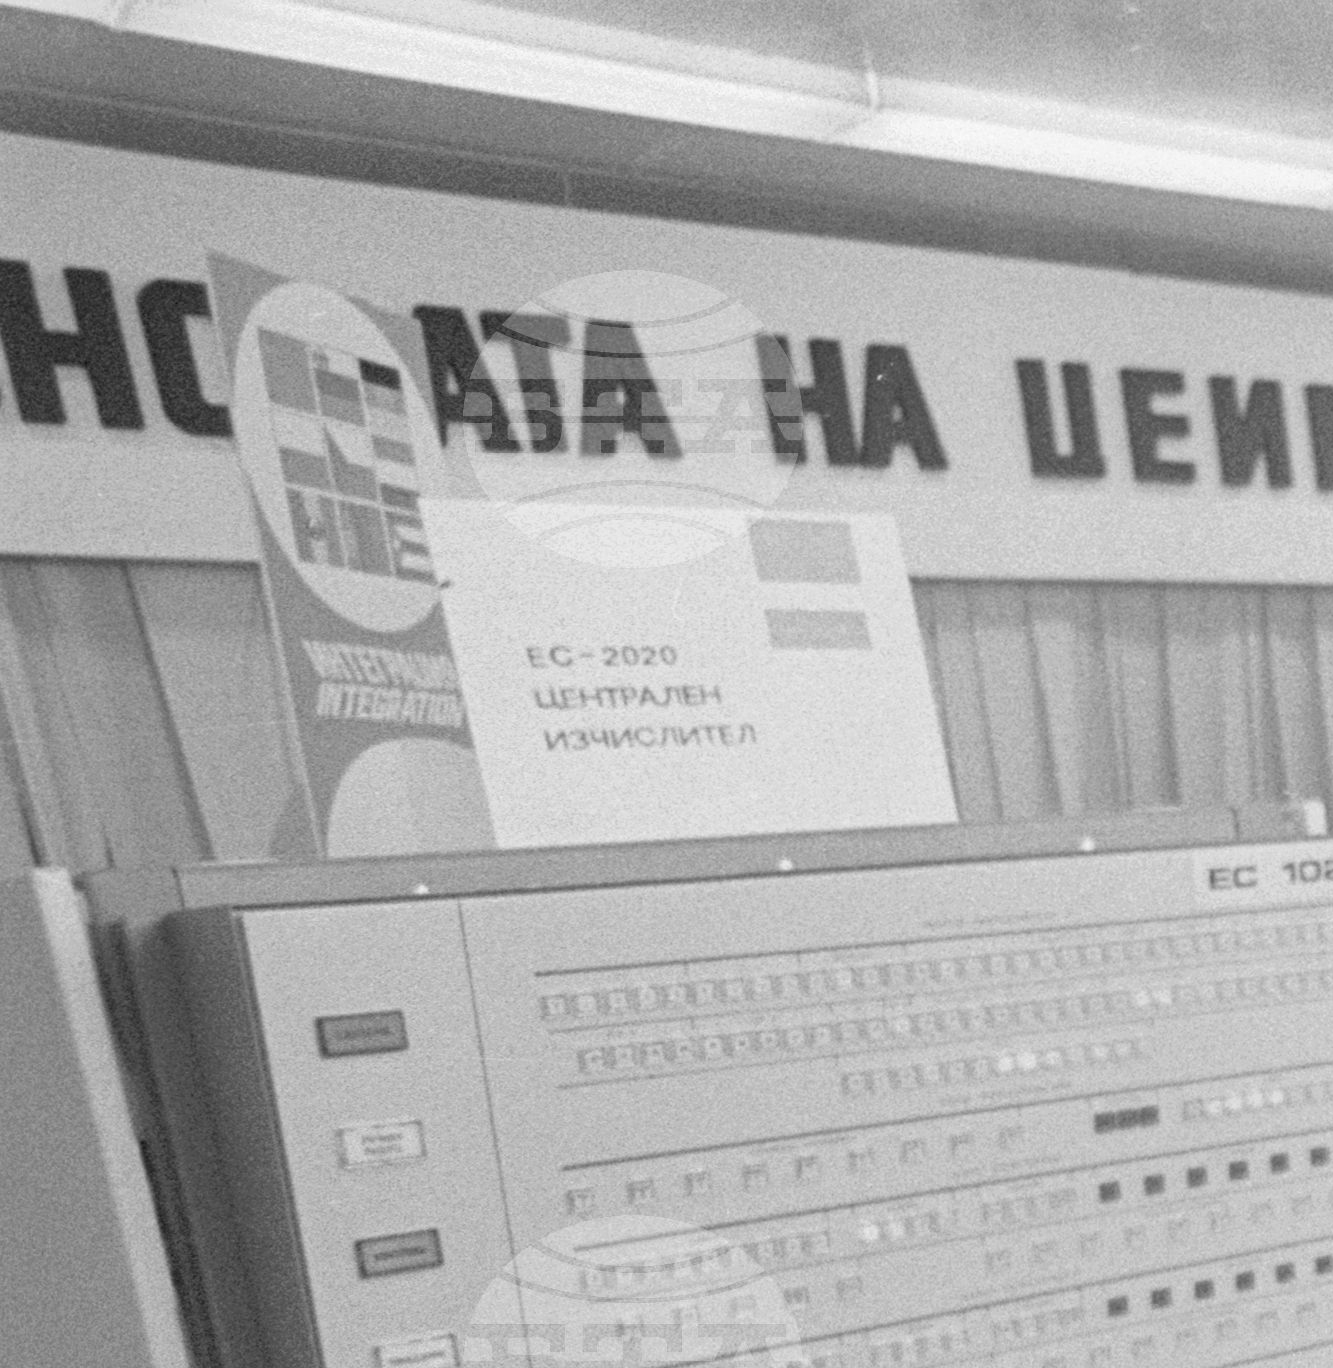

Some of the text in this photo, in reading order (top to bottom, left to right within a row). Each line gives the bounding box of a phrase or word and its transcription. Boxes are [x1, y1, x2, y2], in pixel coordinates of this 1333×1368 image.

[754, 334, 950, 471] НА
[532, 684, 723, 710] ЦЕНТРАЛЕН
[543, 723, 757, 751] ИЗЧИСЛИТЕЛ
[1208, 865, 1259, 891] ЕС
